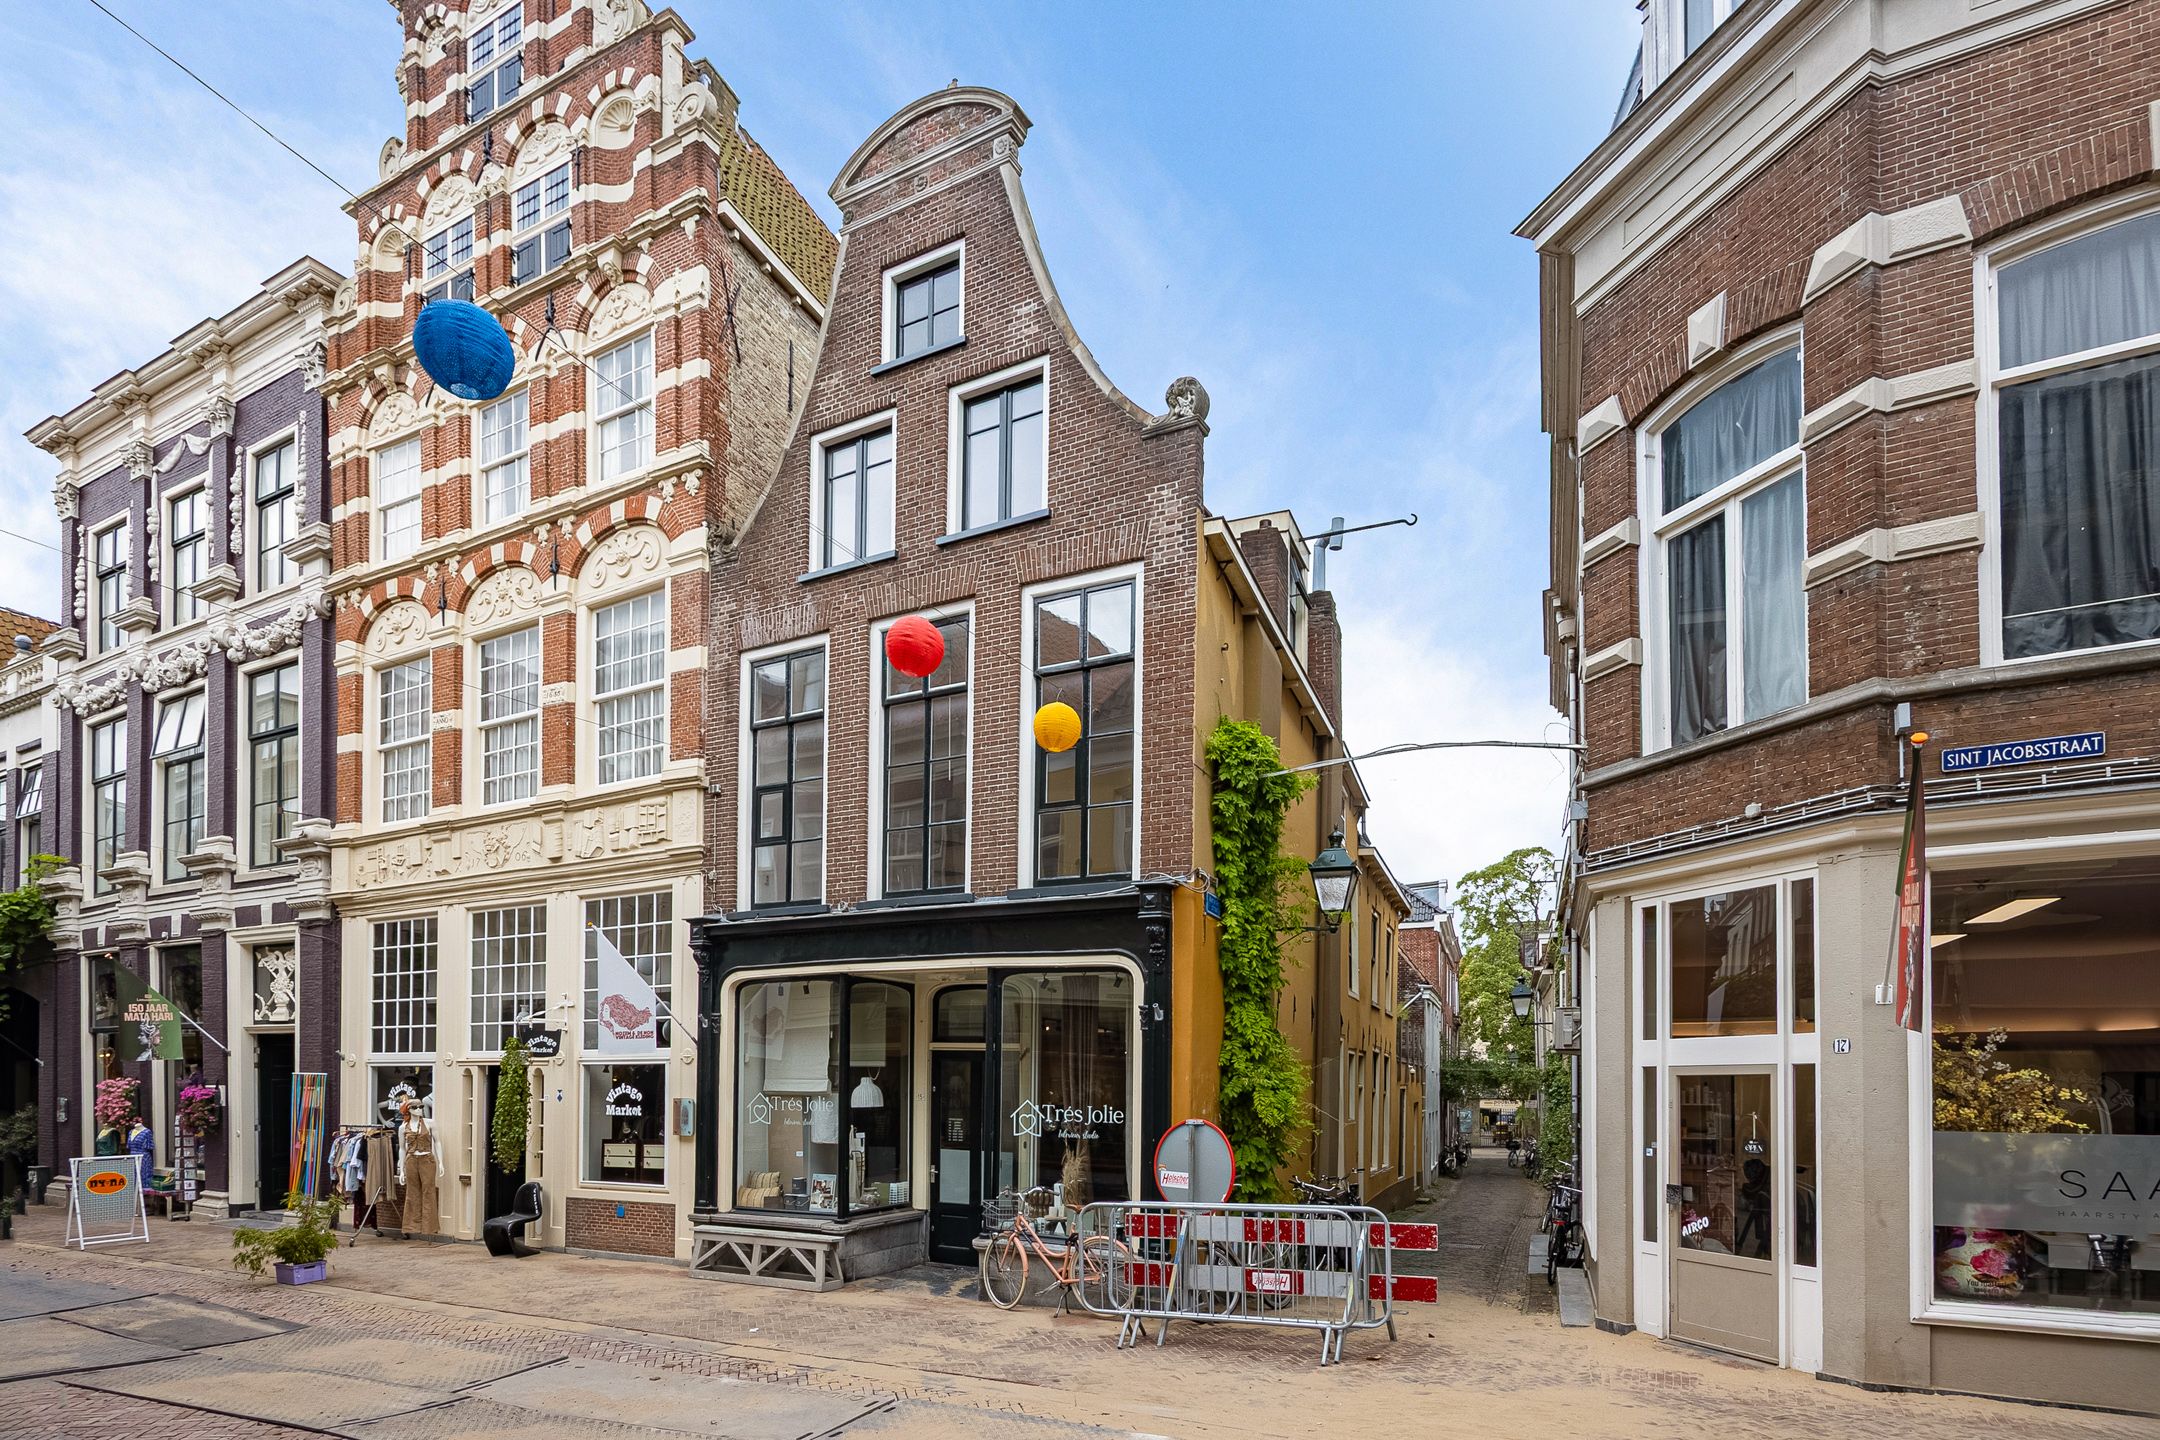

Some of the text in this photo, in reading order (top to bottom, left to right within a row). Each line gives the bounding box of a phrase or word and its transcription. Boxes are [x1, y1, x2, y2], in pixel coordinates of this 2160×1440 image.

[1947, 736, 2102, 767] SINT JACOBSSTRAAT
[124, 1012, 174, 1021] MATA HARI
[128, 1004, 168, 1012] 150 JAAR
[528, 1035, 557, 1048] Vintage
[1837, 1040, 1847, 1052] 17
[388, 1081, 416, 1098] Vintage
[606, 1083, 643, 1103] Vintage
[606, 1104, 642, 1116] Market
[771, 1096, 834, 1114] Trés Jolie
[1042, 1104, 1124, 1126] Trés Jolie
[1682, 1216, 1709, 1236] AIRCO
